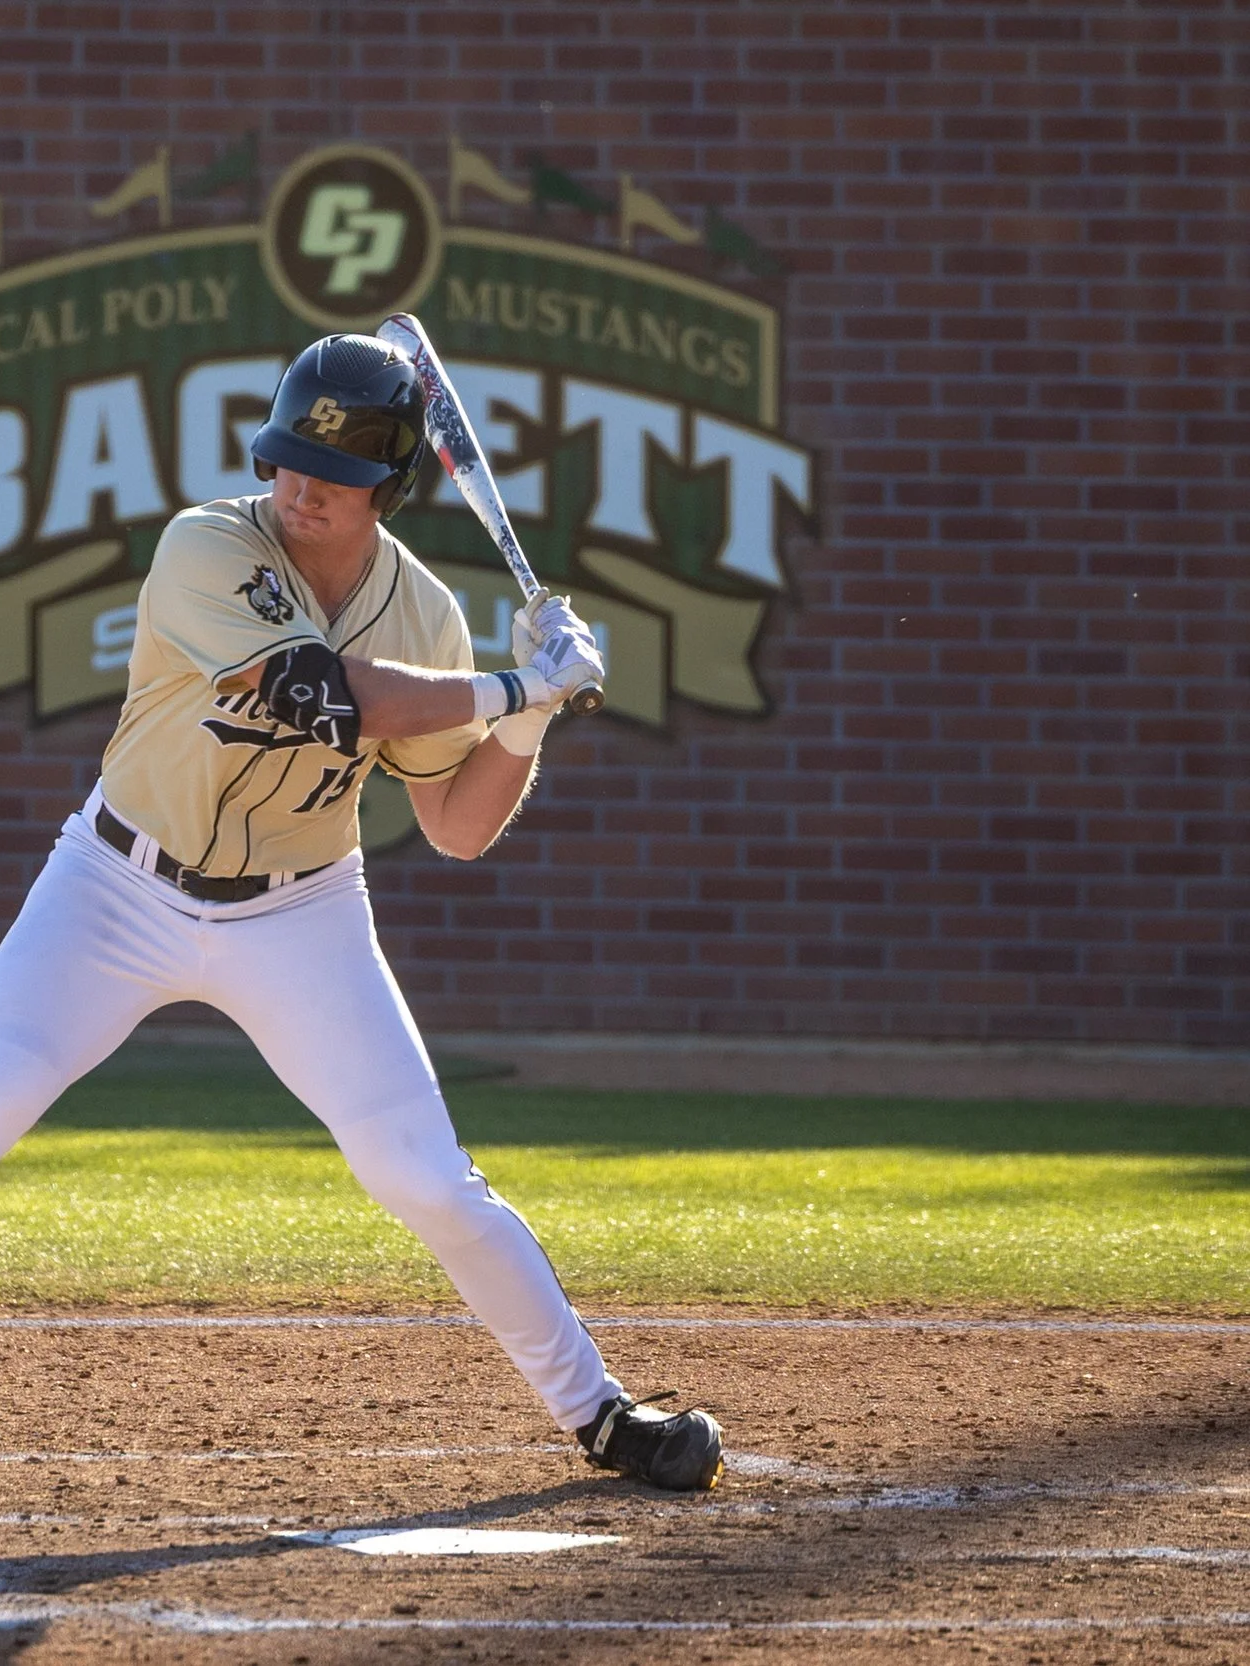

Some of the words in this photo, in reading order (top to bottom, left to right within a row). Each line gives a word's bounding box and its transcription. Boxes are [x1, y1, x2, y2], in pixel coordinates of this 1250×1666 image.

[104, 276, 236, 335] POLY
[446, 277, 749, 388] MUSTANGS
[310, 396, 347, 434] CP
